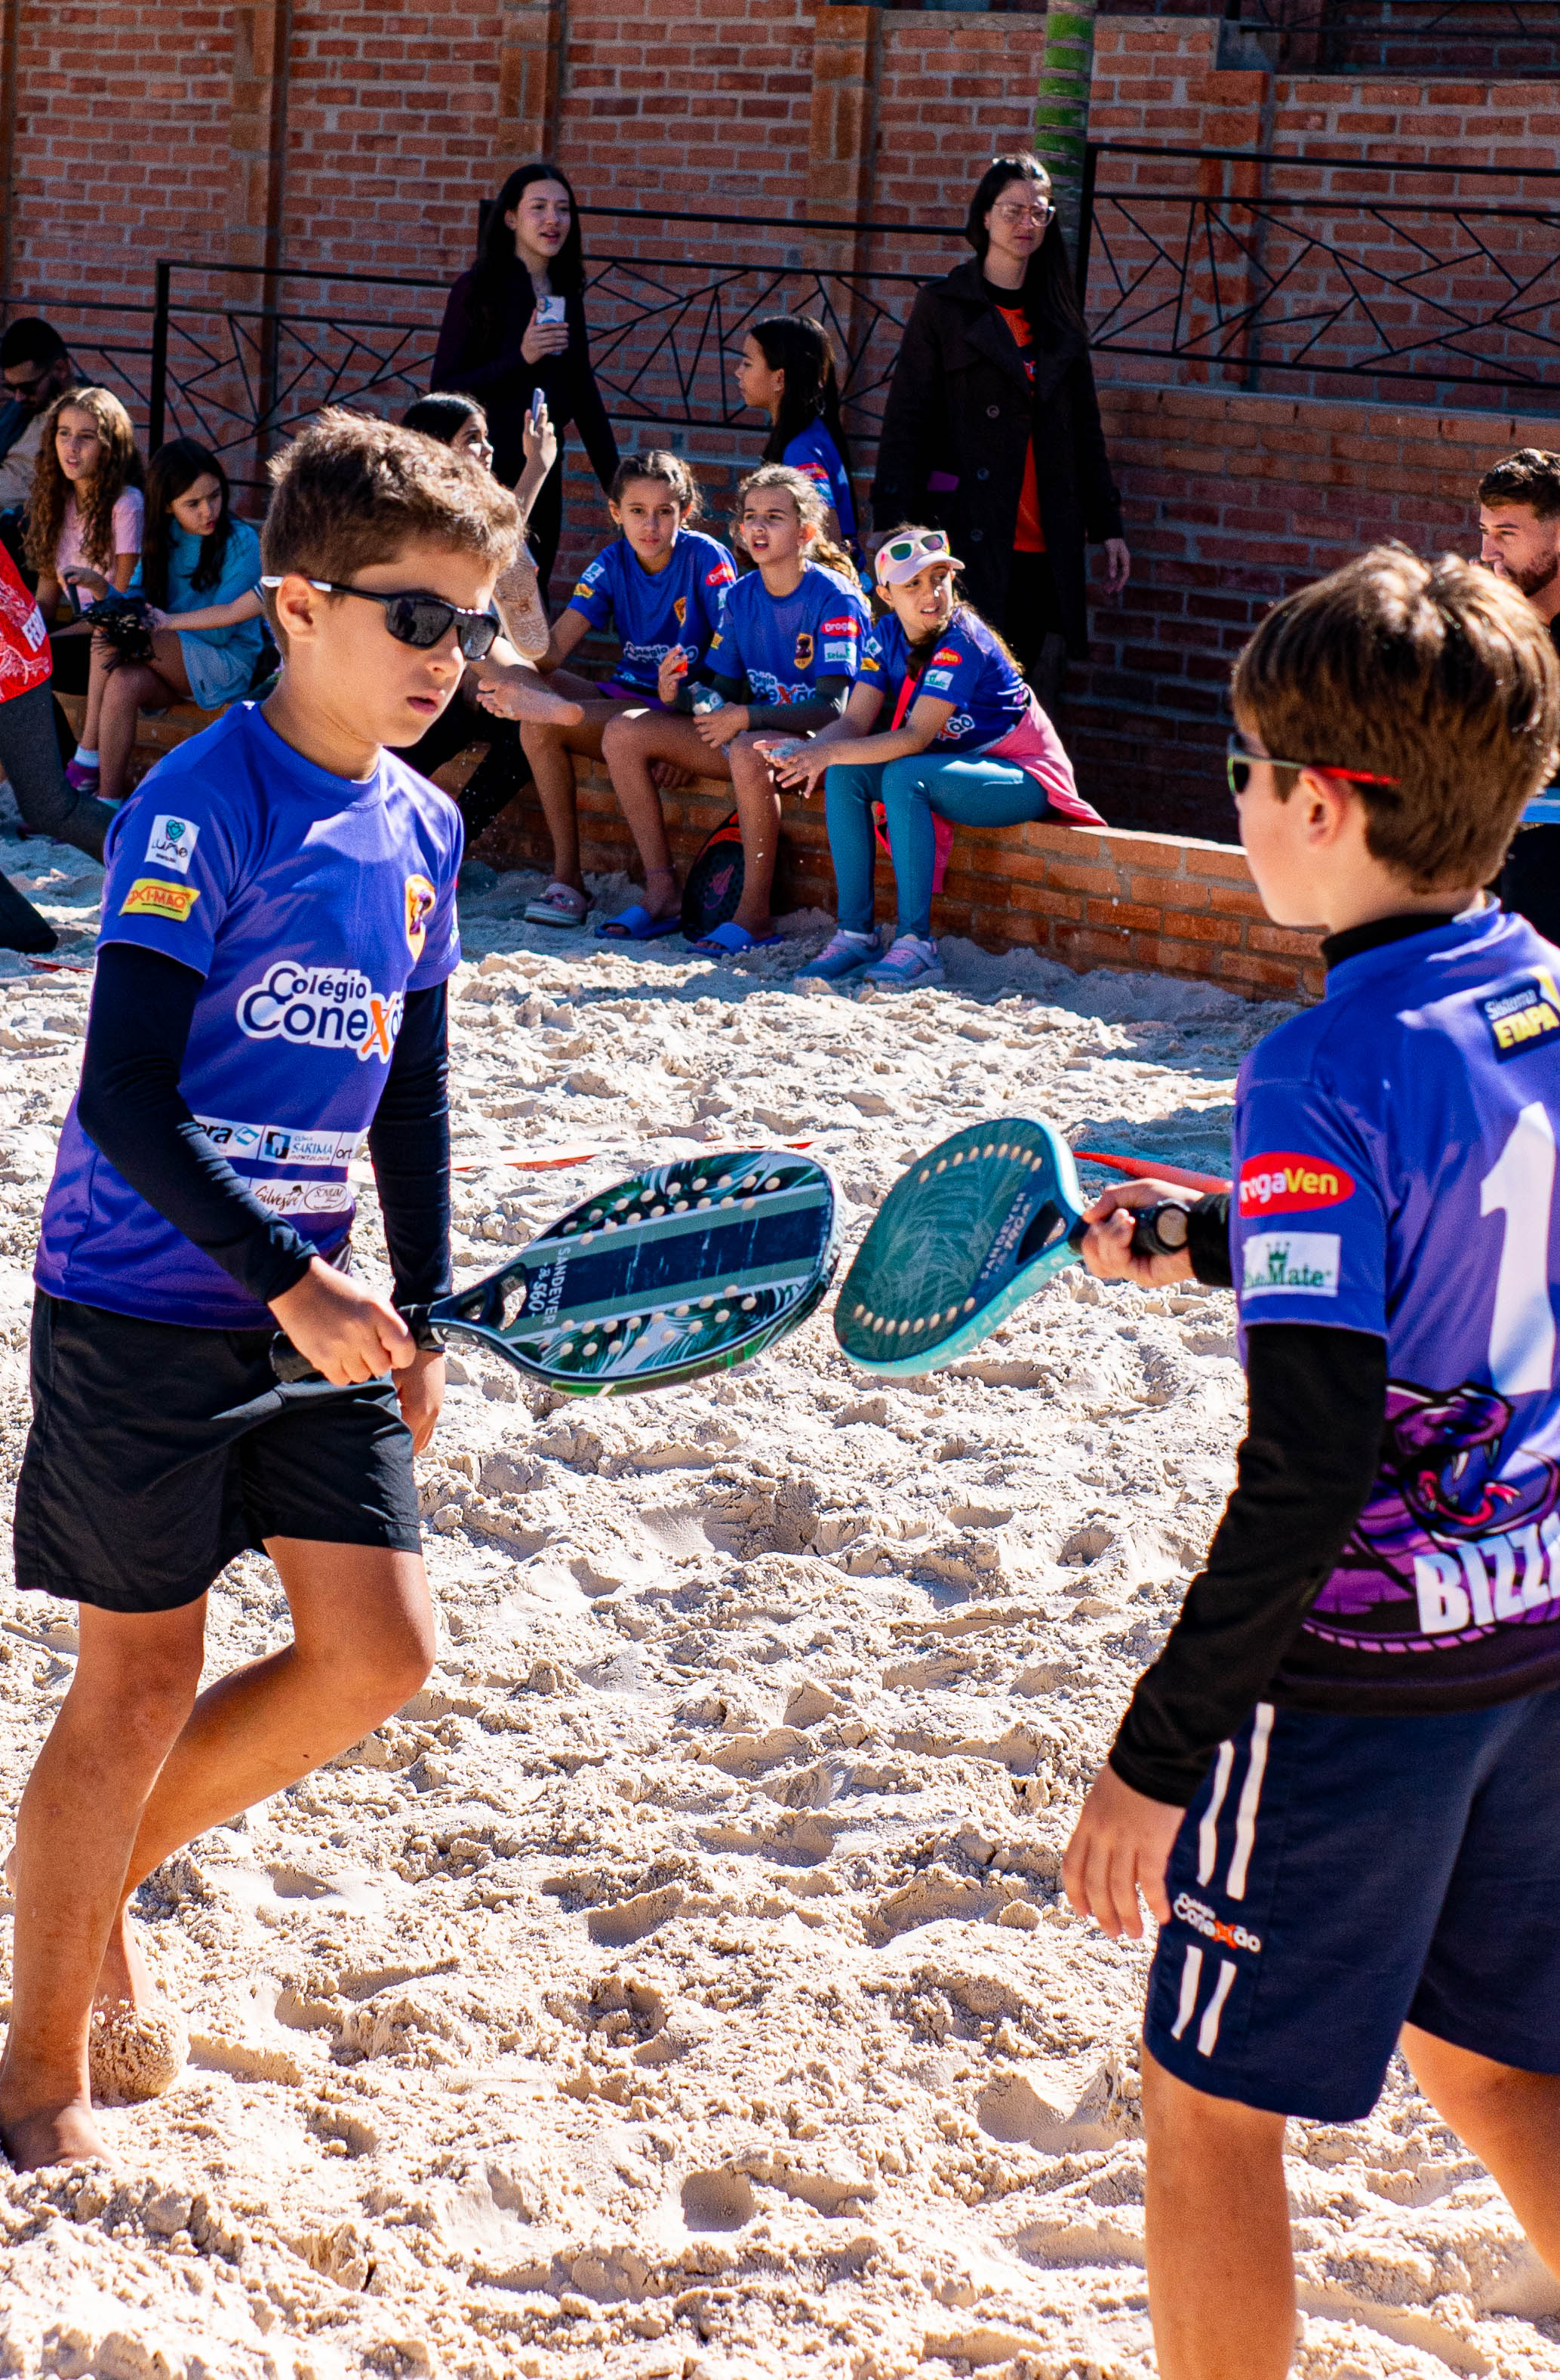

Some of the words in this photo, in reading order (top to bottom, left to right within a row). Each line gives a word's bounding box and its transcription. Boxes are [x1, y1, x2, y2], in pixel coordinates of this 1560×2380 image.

[269, 967, 368, 1004] Colégio
[1493, 1002, 1560, 1049] ETAPA
[1480, 1101, 1557, 1396] 1
[543, 1246, 571, 1326] SANDEVER
